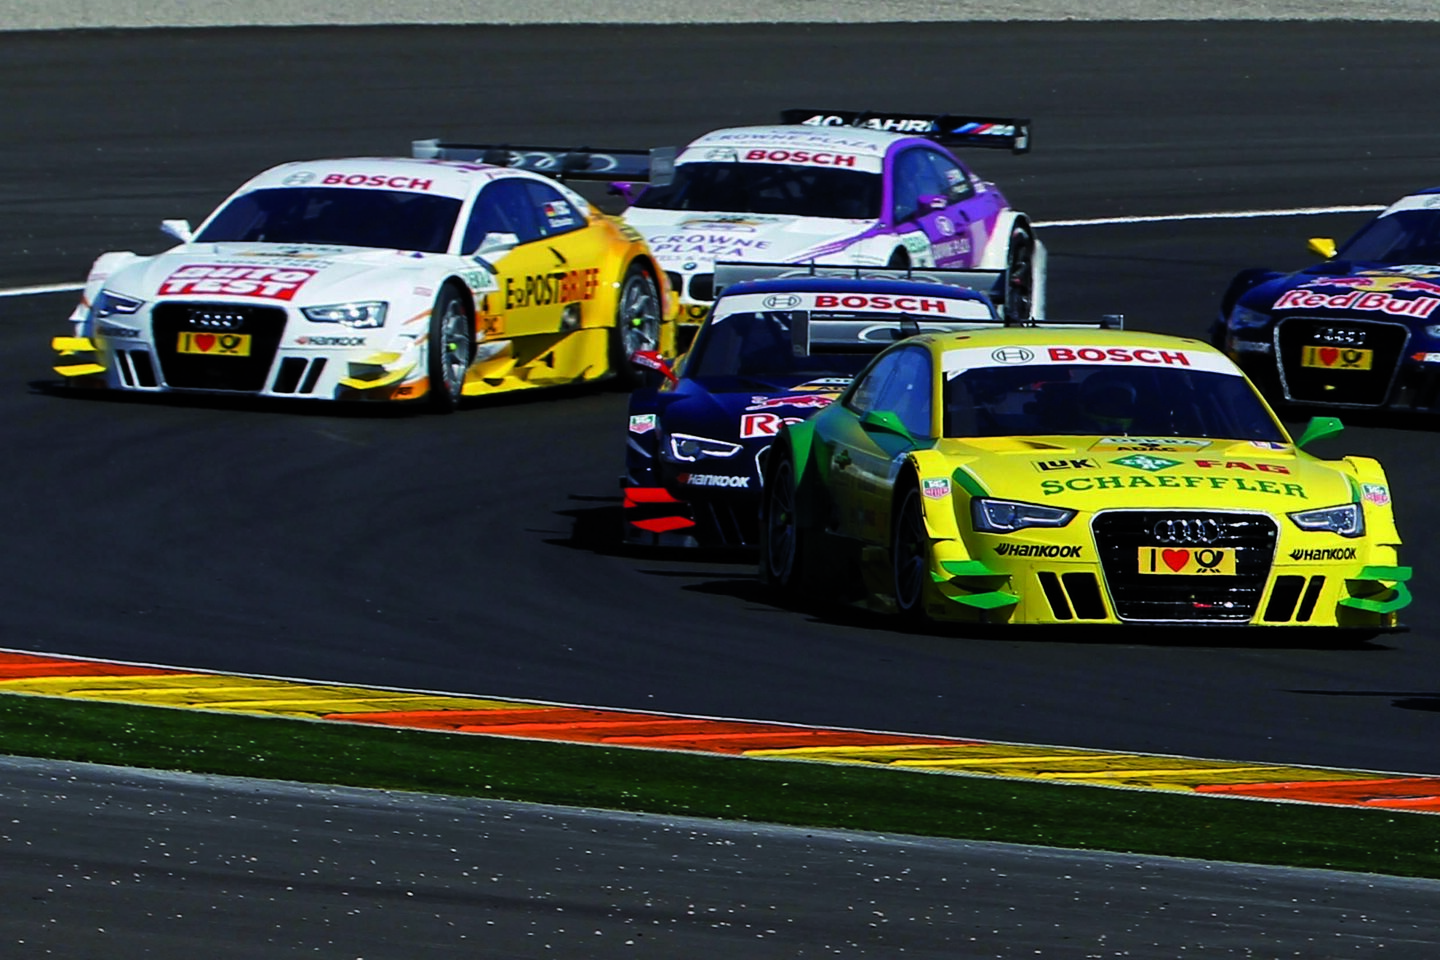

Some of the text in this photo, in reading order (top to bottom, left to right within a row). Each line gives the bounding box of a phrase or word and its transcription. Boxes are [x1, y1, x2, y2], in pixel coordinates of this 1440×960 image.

[745, 149, 856, 167] BOSCH
[321, 173, 433, 190] BOSCH
[648, 234, 771, 249] CROWNE
[654, 244, 744, 256] PLAZA
[170, 266, 315, 283] AUTO
[162, 278, 303, 297] TEST
[814, 295, 947, 314] BOSCH
[1272, 290, 1361, 309] Red
[1047, 346, 1191, 367] BOSCH
[1194, 459, 1291, 475] FAG
[1039, 475, 1309, 500] SCHAEFFLER
